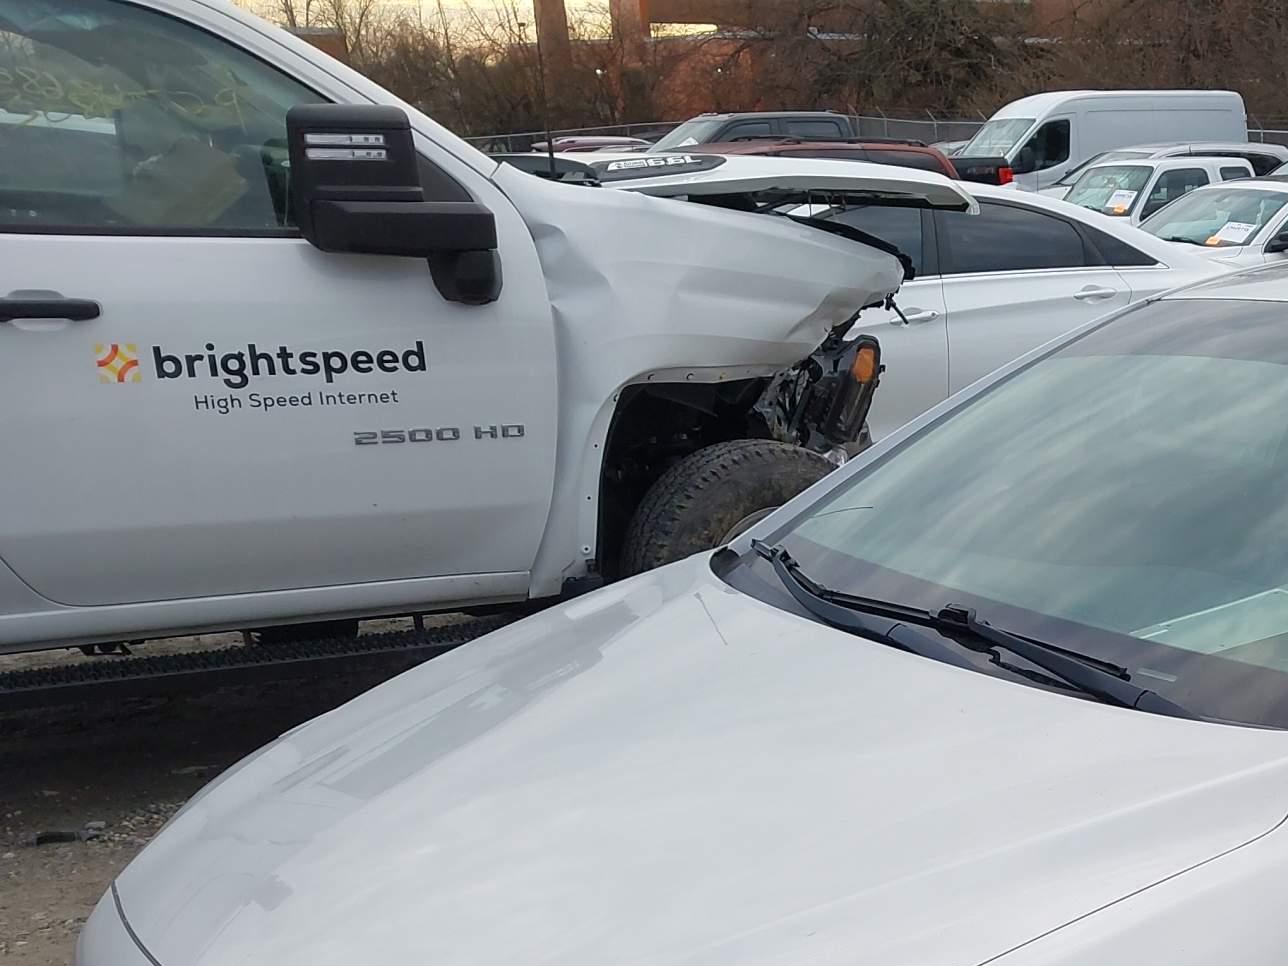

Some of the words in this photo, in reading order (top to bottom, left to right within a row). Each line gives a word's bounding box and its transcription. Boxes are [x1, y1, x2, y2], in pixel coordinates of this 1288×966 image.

[153, 341, 427, 389] brightspeed
[194, 394, 242, 414] High
[249, 391, 313, 412] Speed
[319, 388, 400, 406] Internet
[353, 429, 461, 446] 2500
[473, 424, 526, 440] HD
